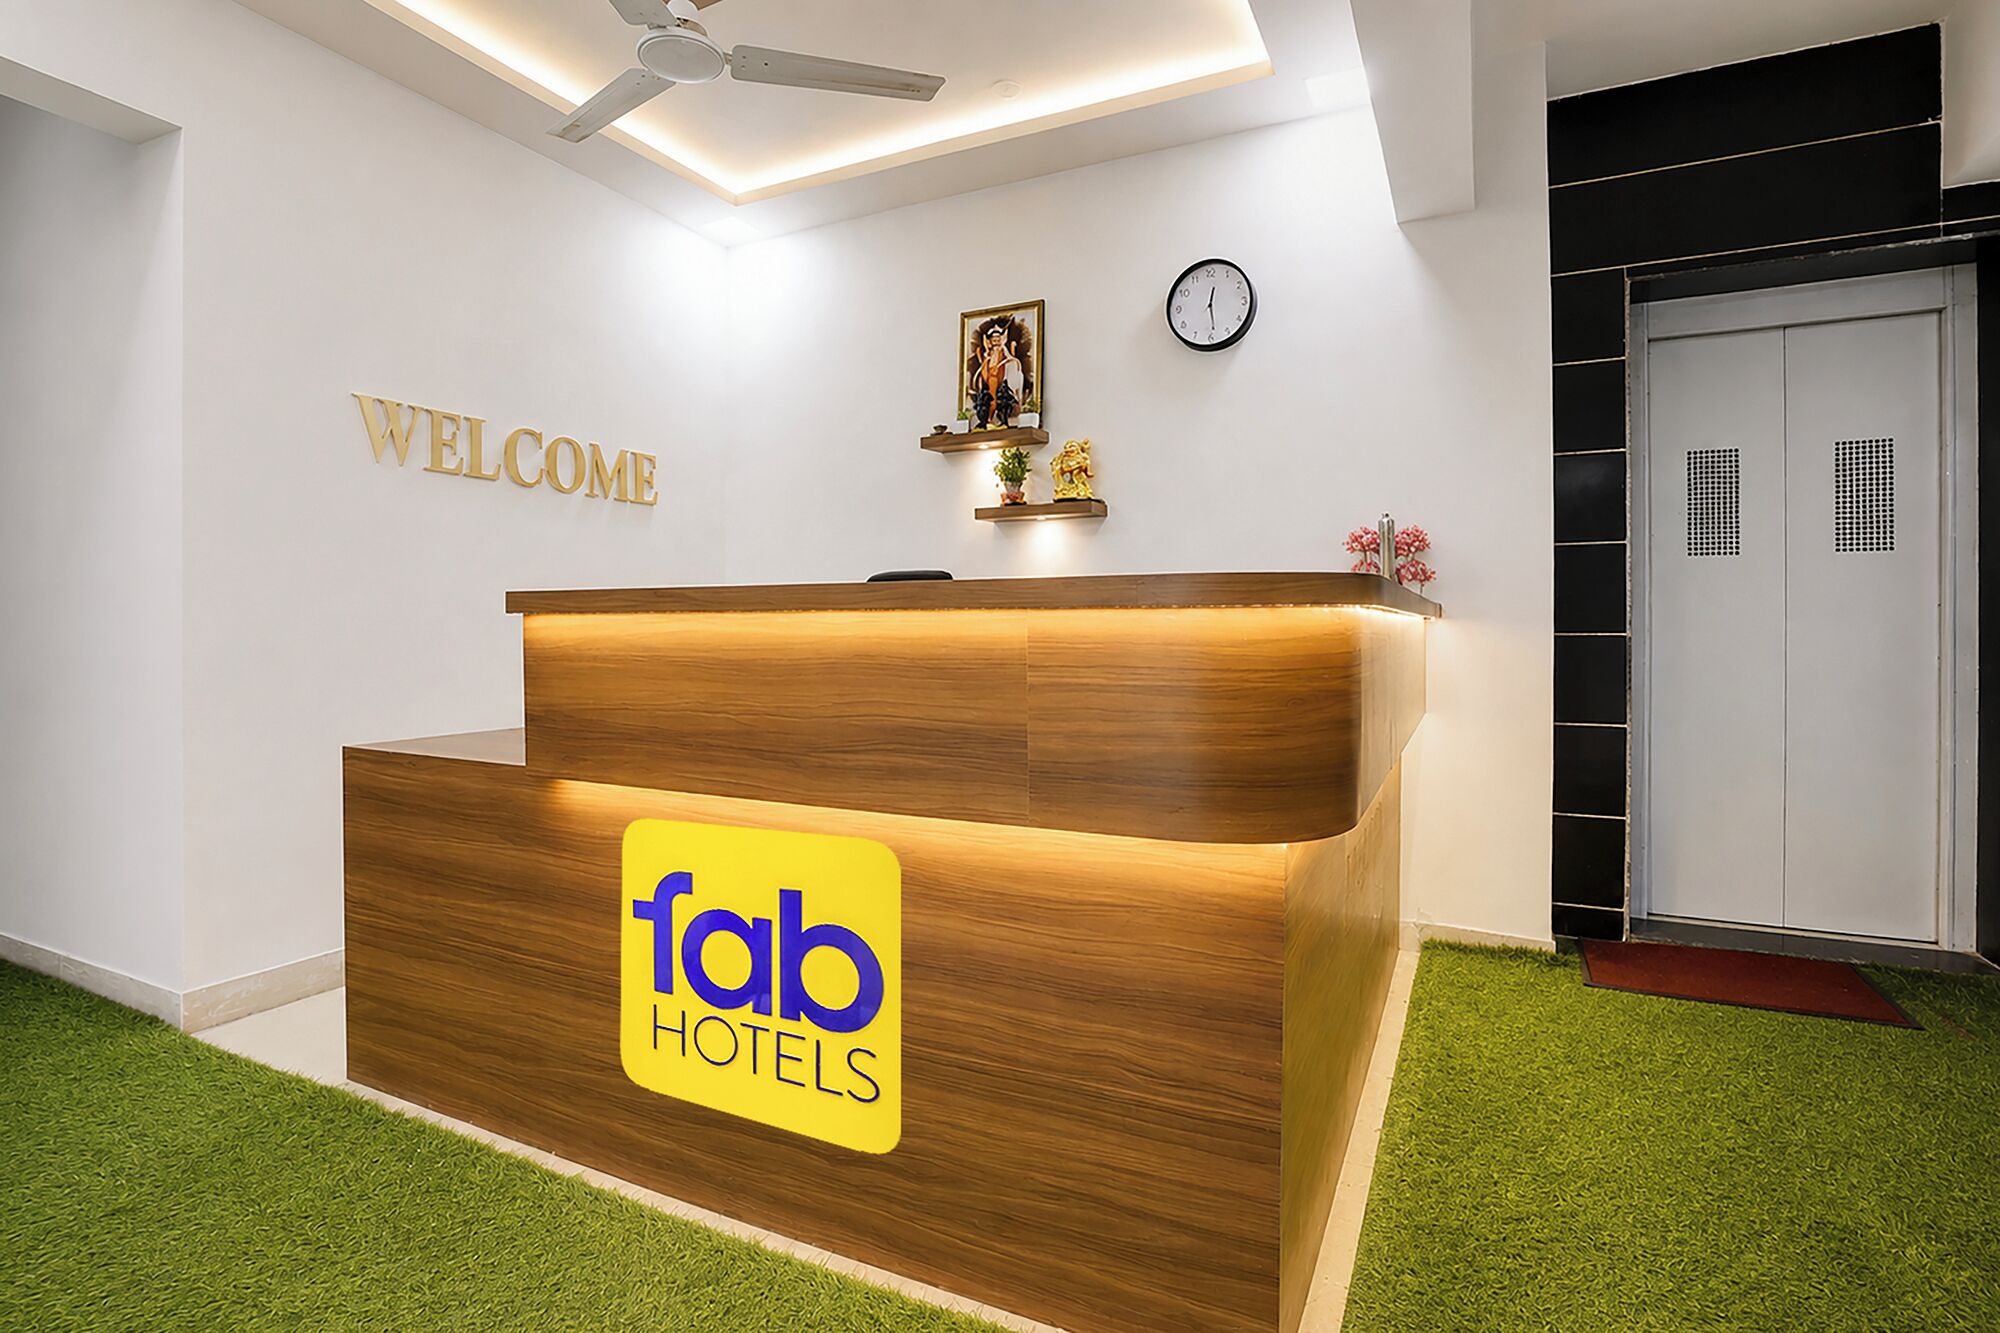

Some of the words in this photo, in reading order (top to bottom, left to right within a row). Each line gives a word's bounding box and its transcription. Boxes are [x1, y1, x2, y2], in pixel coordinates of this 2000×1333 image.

[1205, 267, 1216, 278] 12
[1191, 275, 1199, 284] 11
[1236, 280, 1242, 290] 2
[1179, 288, 1190, 298] 10
[1241, 296, 1248, 306] 3
[1175, 305, 1182, 314] 9
[351, 392, 660, 506] WELCOME
[633, 871, 884, 1033] fab
[653, 1004, 881, 1103] HOTELS
